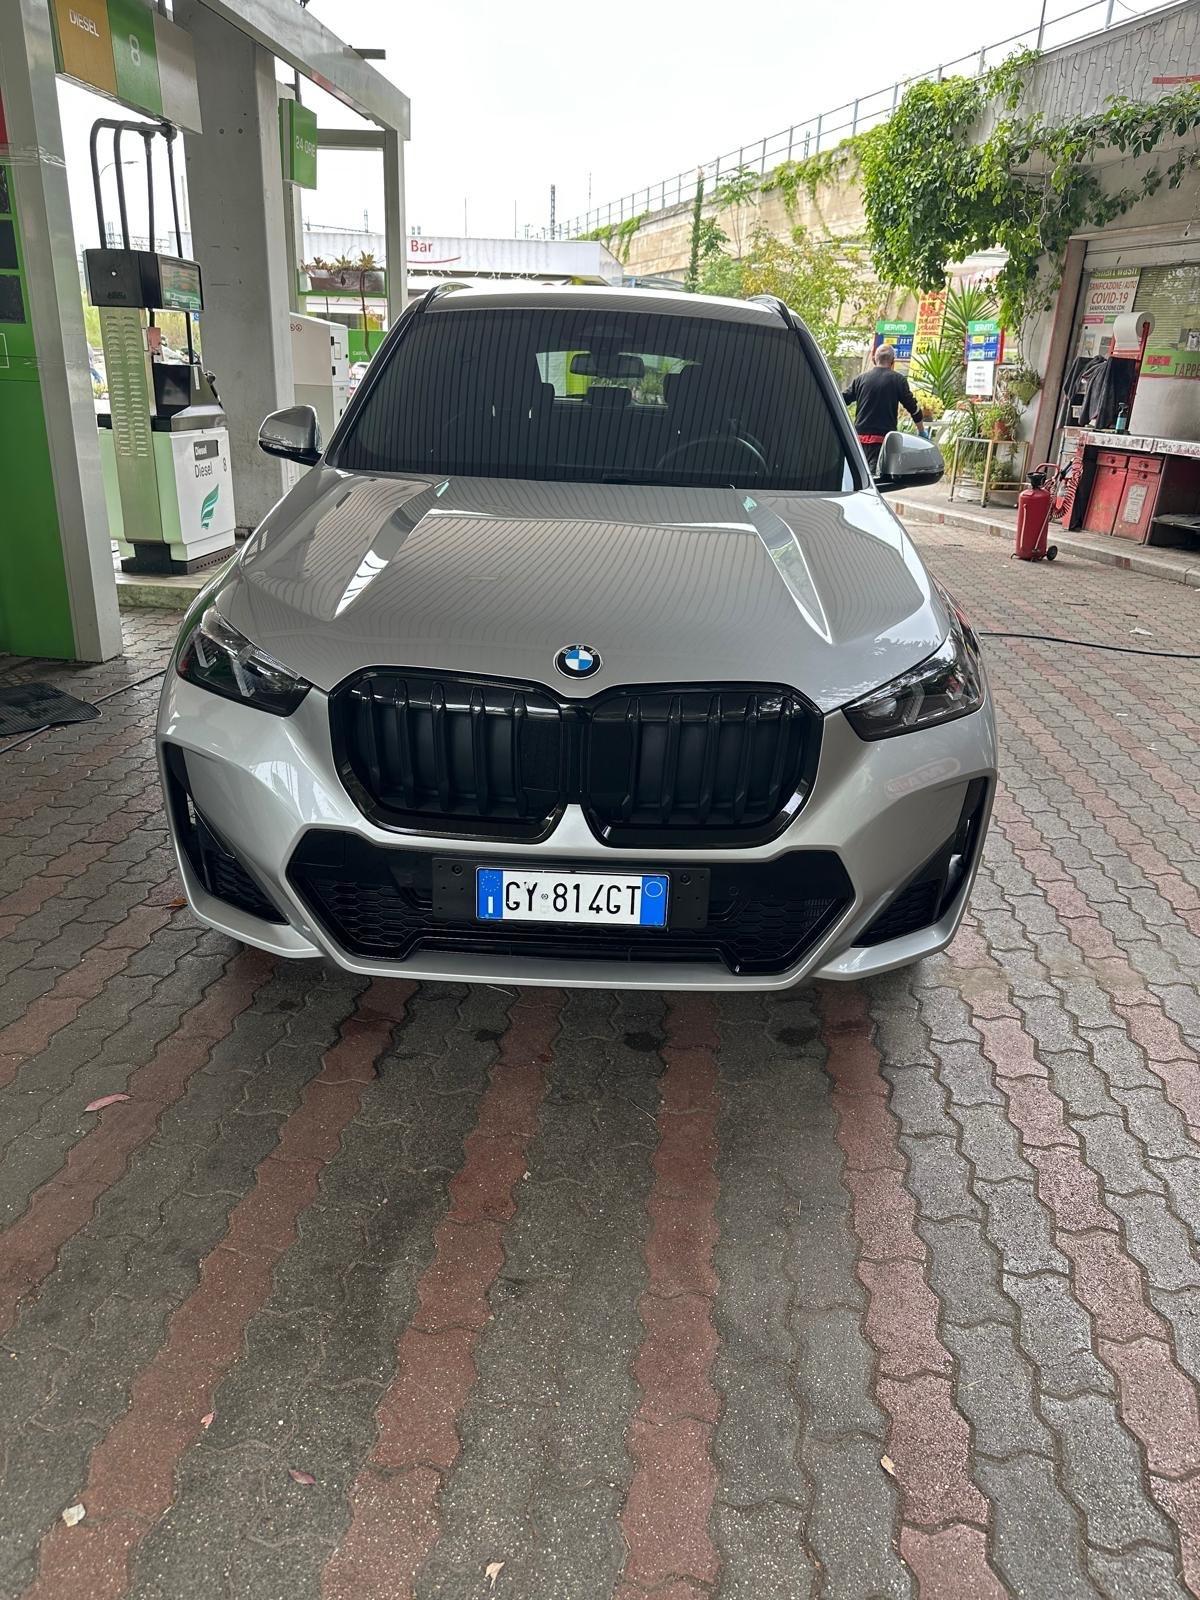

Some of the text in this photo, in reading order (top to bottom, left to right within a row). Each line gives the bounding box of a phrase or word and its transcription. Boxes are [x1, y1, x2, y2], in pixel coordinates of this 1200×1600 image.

[69, 8, 100, 37] DIESEL
[129, 34, 141, 66] 8
[295, 135, 304, 151] 24
[410, 239, 433, 253] Bar
[1091, 291, 1129, 304] COVID-19
[884, 323, 907, 331] SERVITO
[194, 461, 213, 478] Diesel
[222, 457, 228, 472] 8
[562, 644, 598, 656] BMW
[505, 881, 641, 915] GY 814GT
